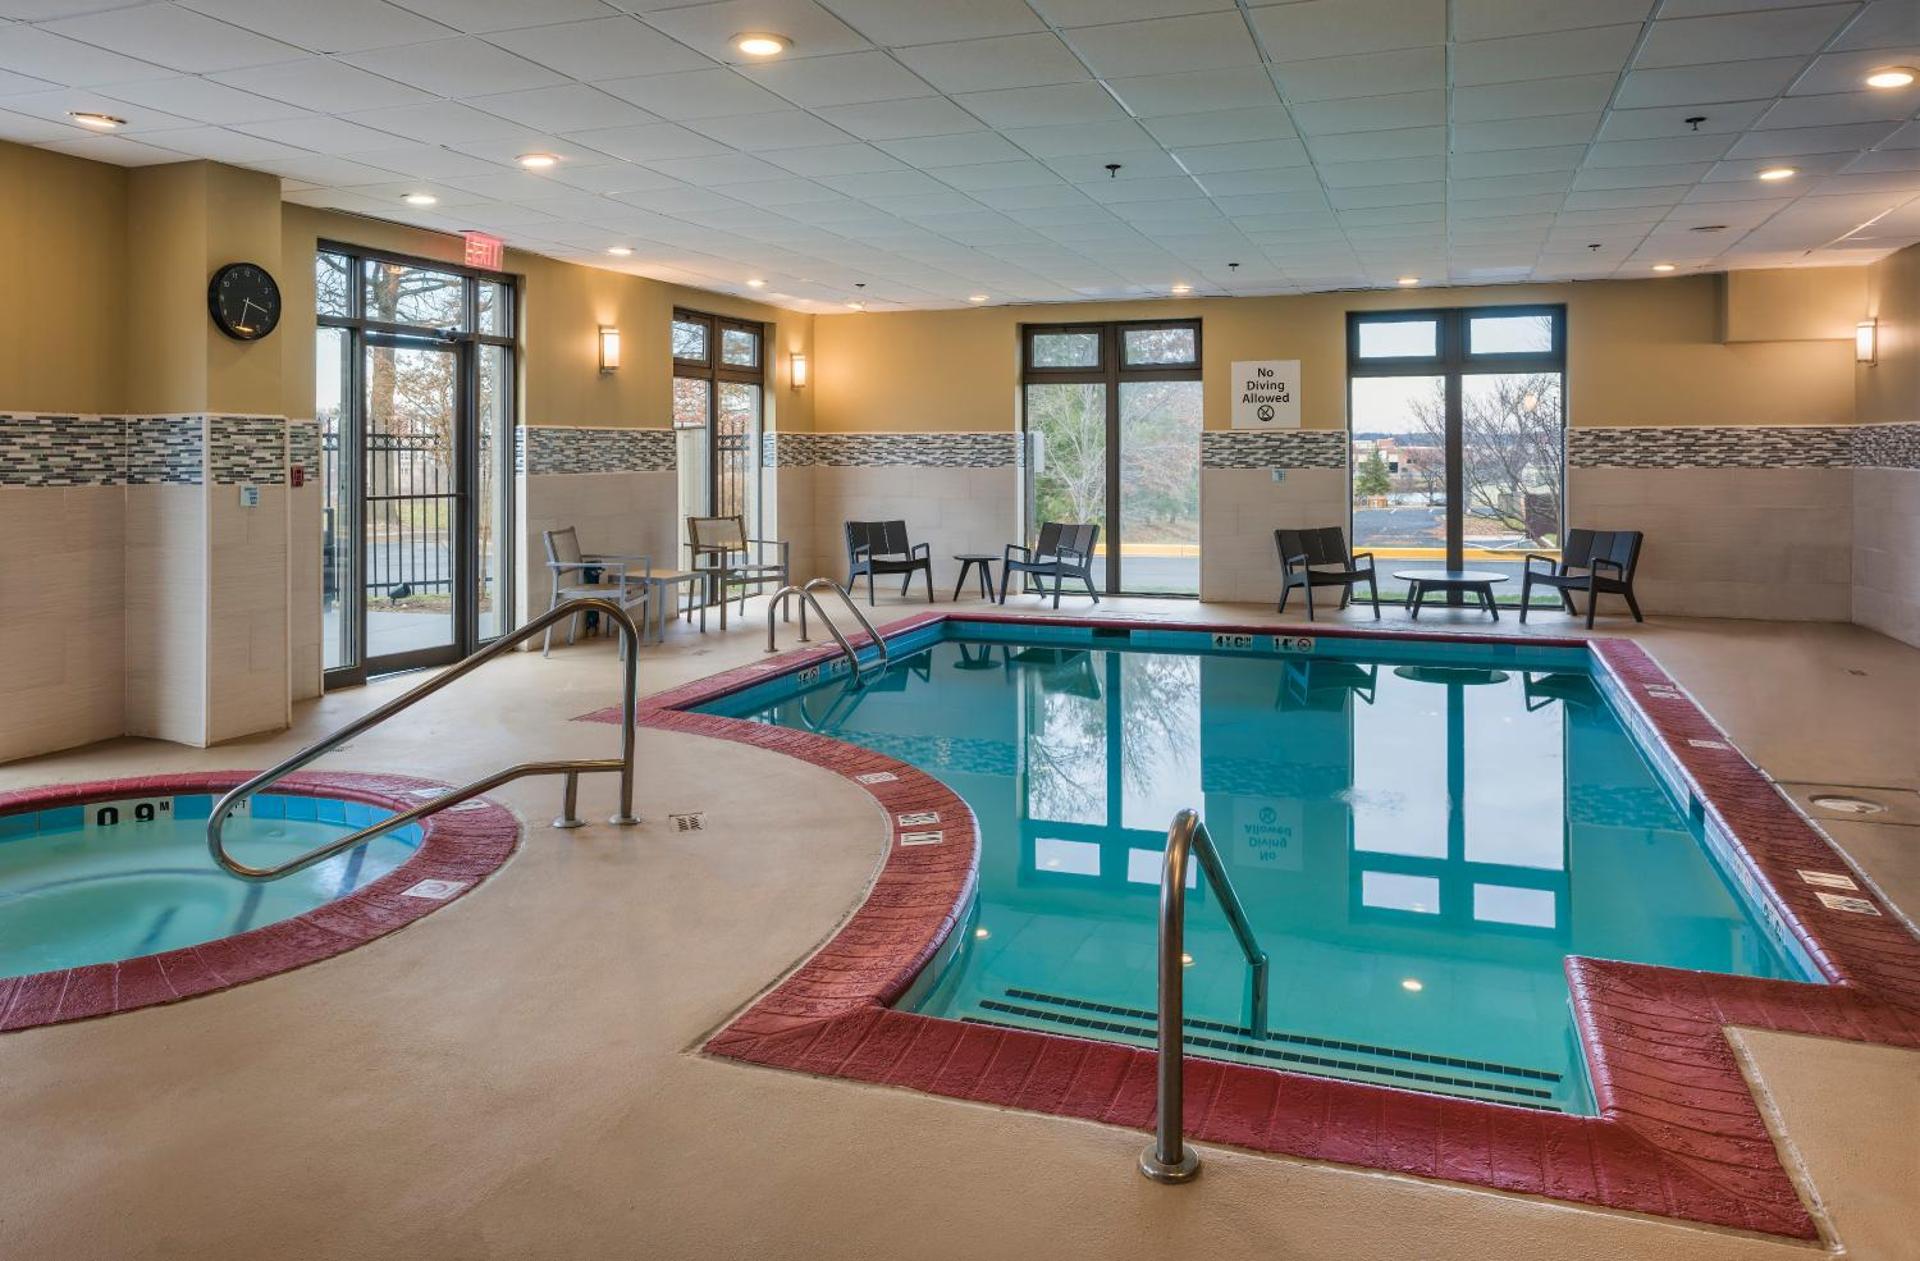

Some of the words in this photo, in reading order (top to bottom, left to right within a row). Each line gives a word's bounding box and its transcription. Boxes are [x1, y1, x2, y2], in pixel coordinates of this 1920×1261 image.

[1257, 367, 1275, 378] No
[1246, 380, 1286, 393] Diving
[1242, 392, 1290, 404] Allowed
